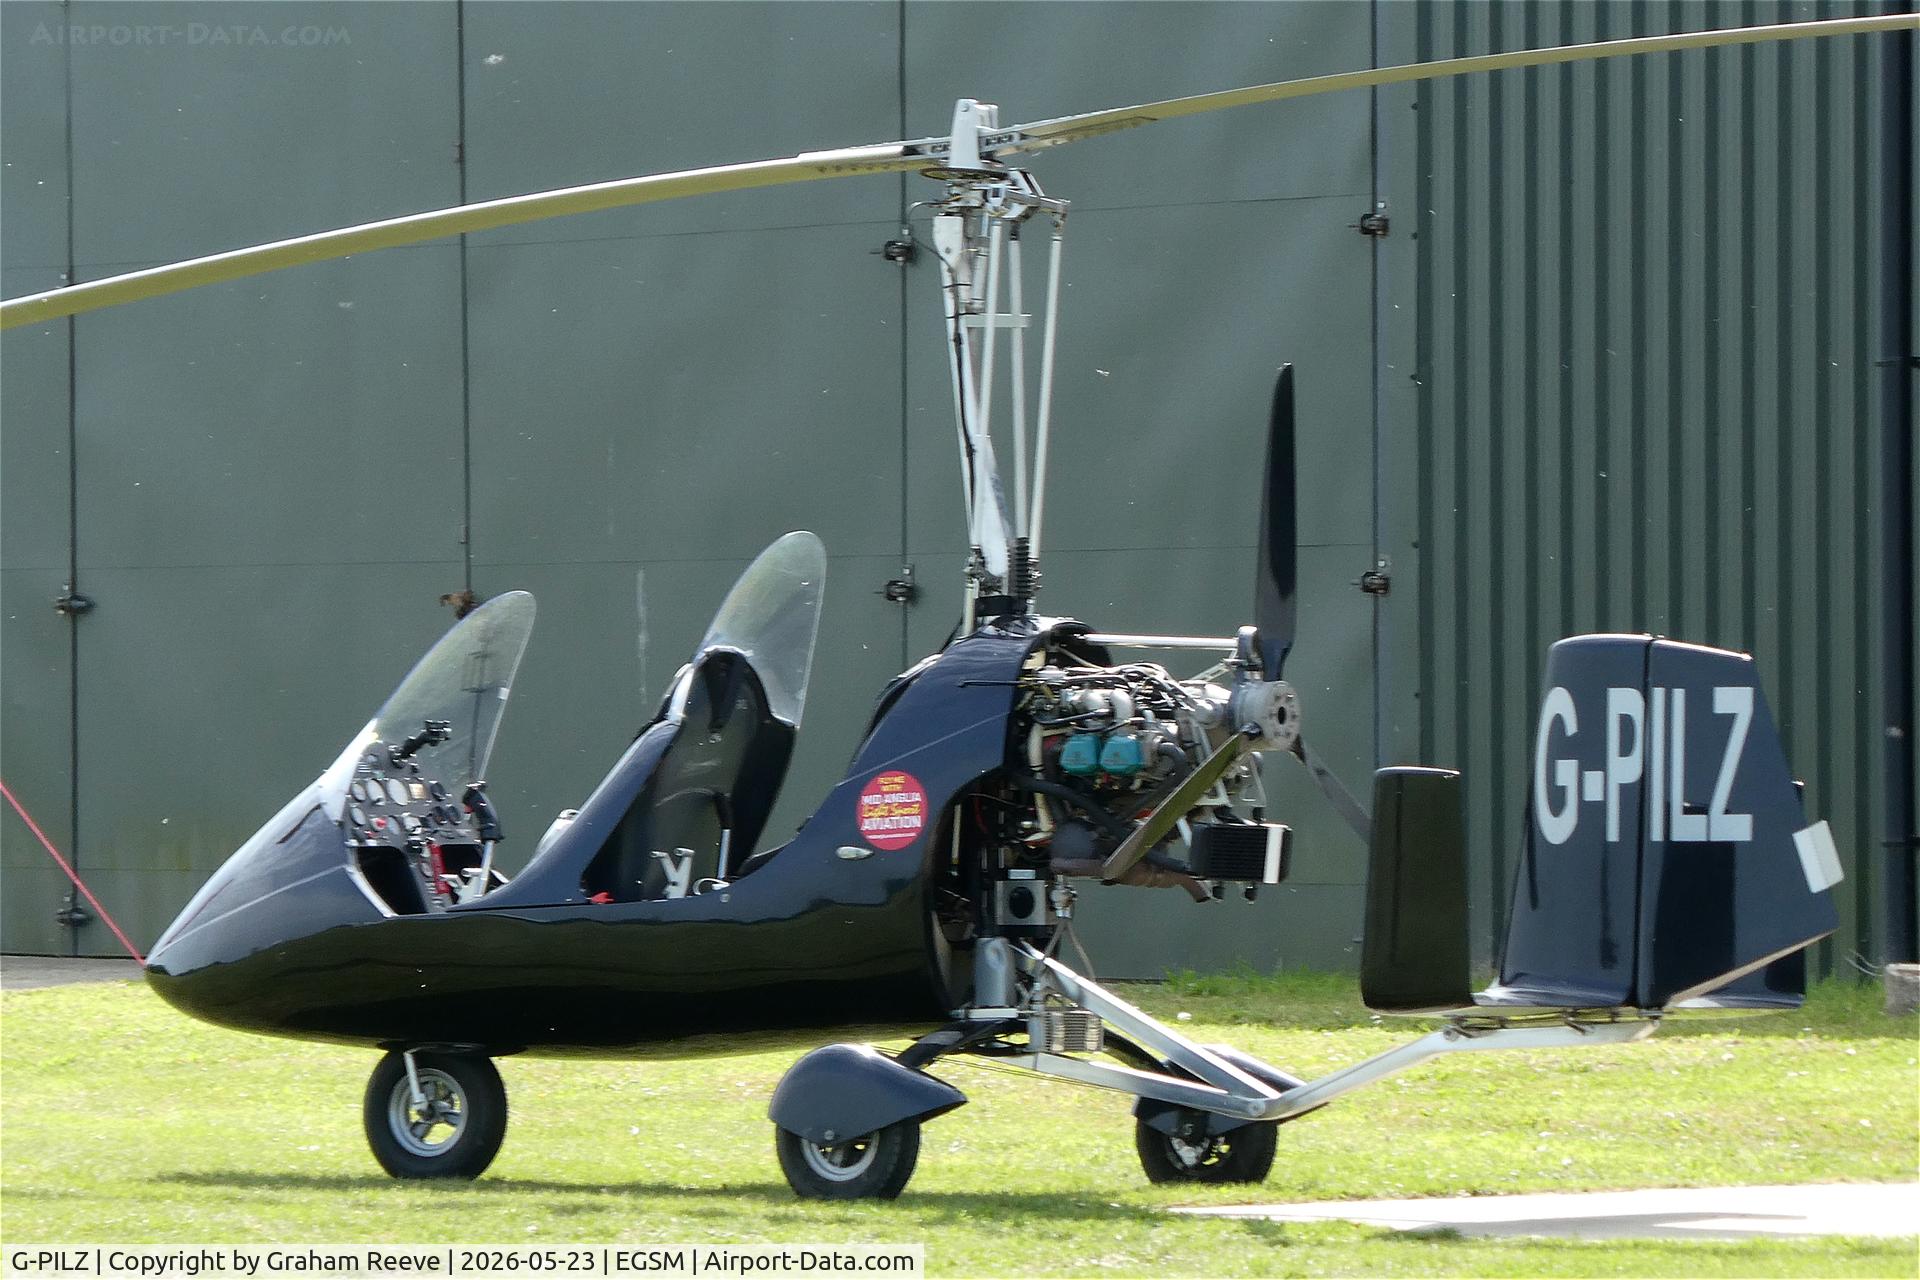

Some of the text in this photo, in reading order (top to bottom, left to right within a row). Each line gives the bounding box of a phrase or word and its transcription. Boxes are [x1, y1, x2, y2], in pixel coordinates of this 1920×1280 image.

[1534, 686, 1754, 845] G-PILZ
[883, 792, 921, 804] ANGLIA
[860, 815, 921, 831] AVIATION
